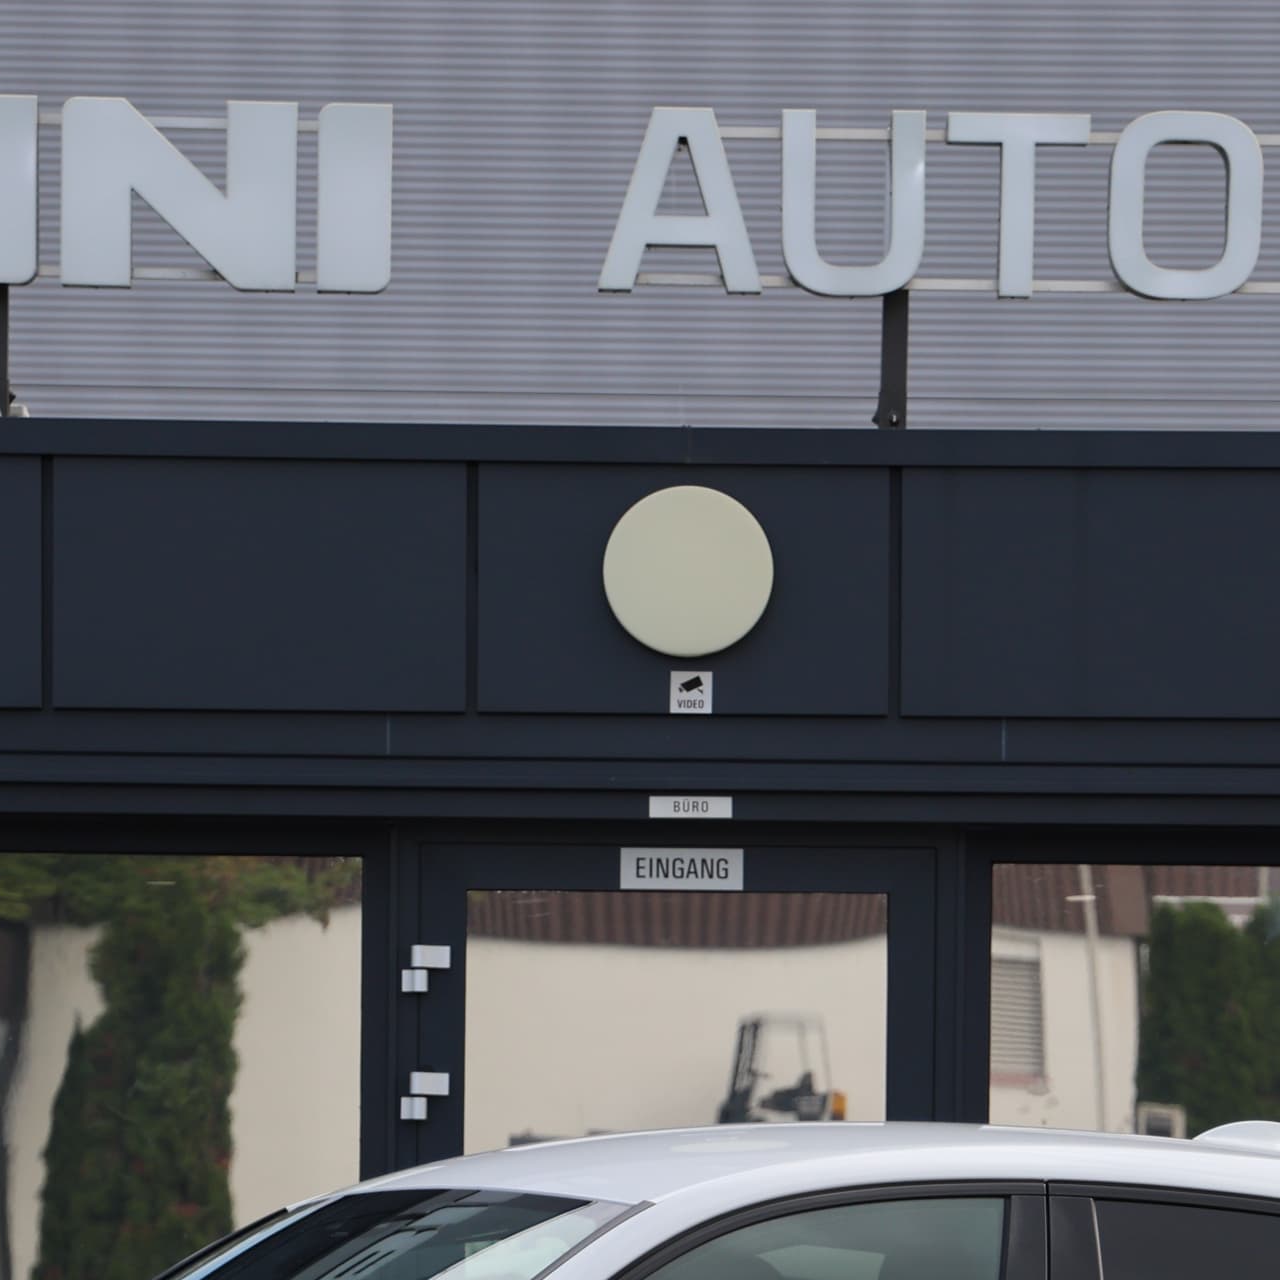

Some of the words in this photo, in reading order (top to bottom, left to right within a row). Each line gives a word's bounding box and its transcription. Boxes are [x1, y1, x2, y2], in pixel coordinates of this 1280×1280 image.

[597, 106, 1265, 300] AUTO
[676, 699, 705, 709] VIDEO
[673, 798, 709, 813] BÜRO
[635, 857, 729, 880] EINGANG
